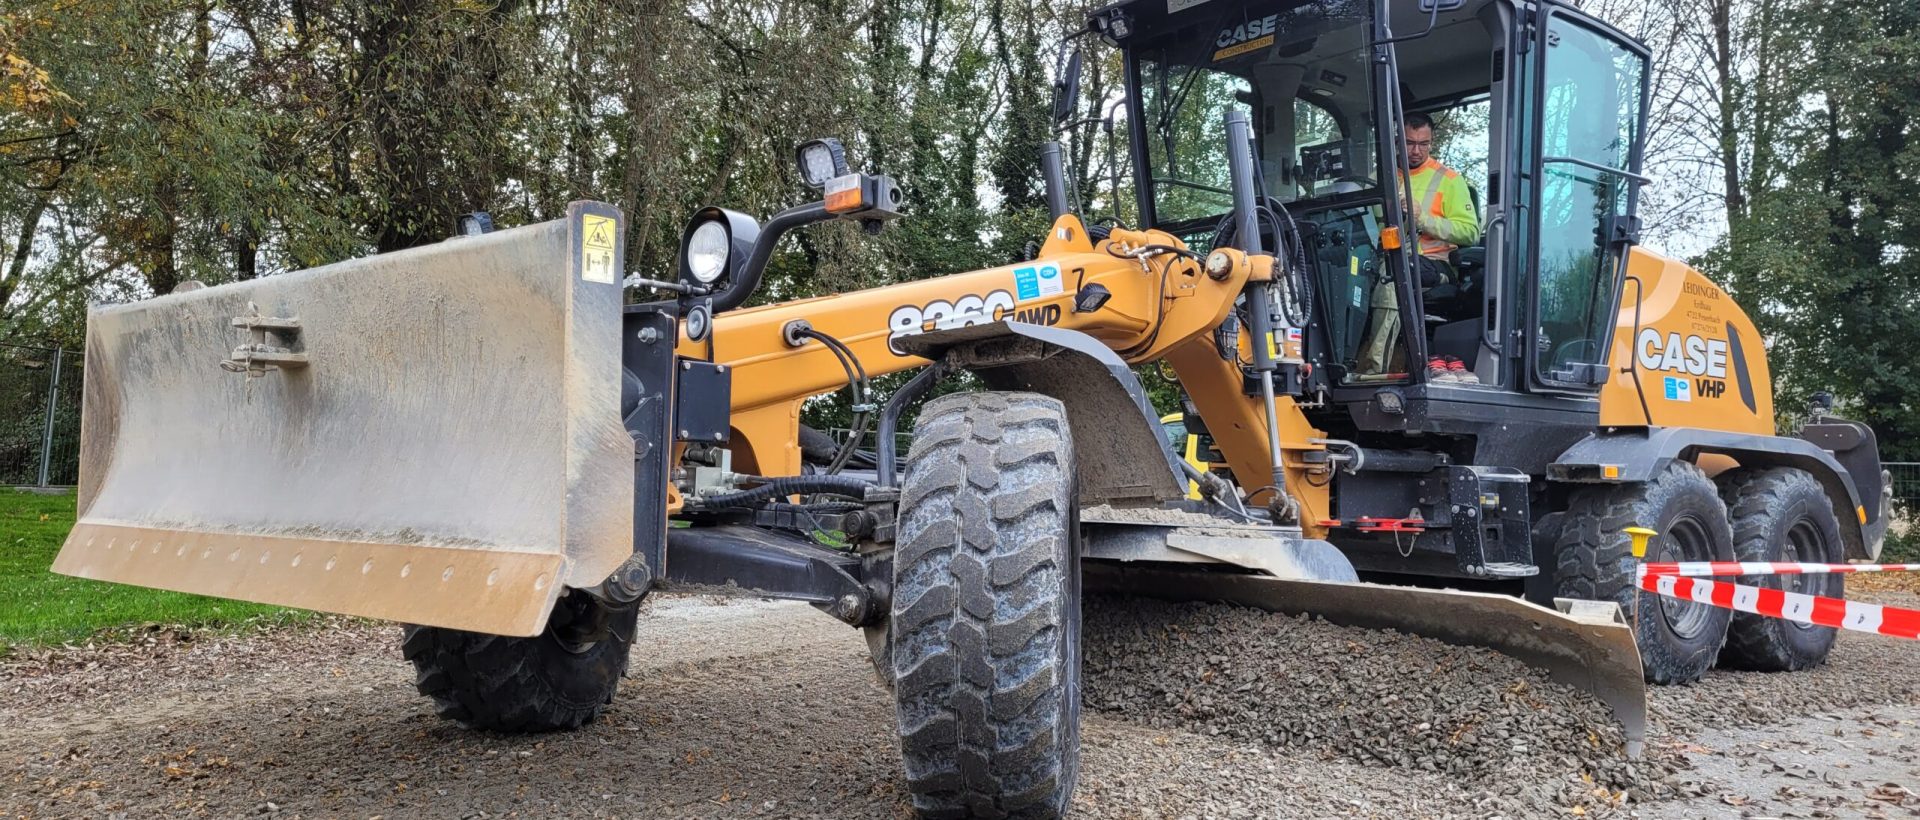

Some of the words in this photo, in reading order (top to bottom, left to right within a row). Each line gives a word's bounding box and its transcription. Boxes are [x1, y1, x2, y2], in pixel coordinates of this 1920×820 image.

[1216, 13, 1278, 48] CASE
[1222, 37, 1273, 56] CONSTRUCTION
[1682, 281, 1720, 300] LEIDINGER
[1016, 303, 1061, 327] AWD
[1637, 327, 1727, 379] CASE
[1696, 379, 1726, 399] VHP
